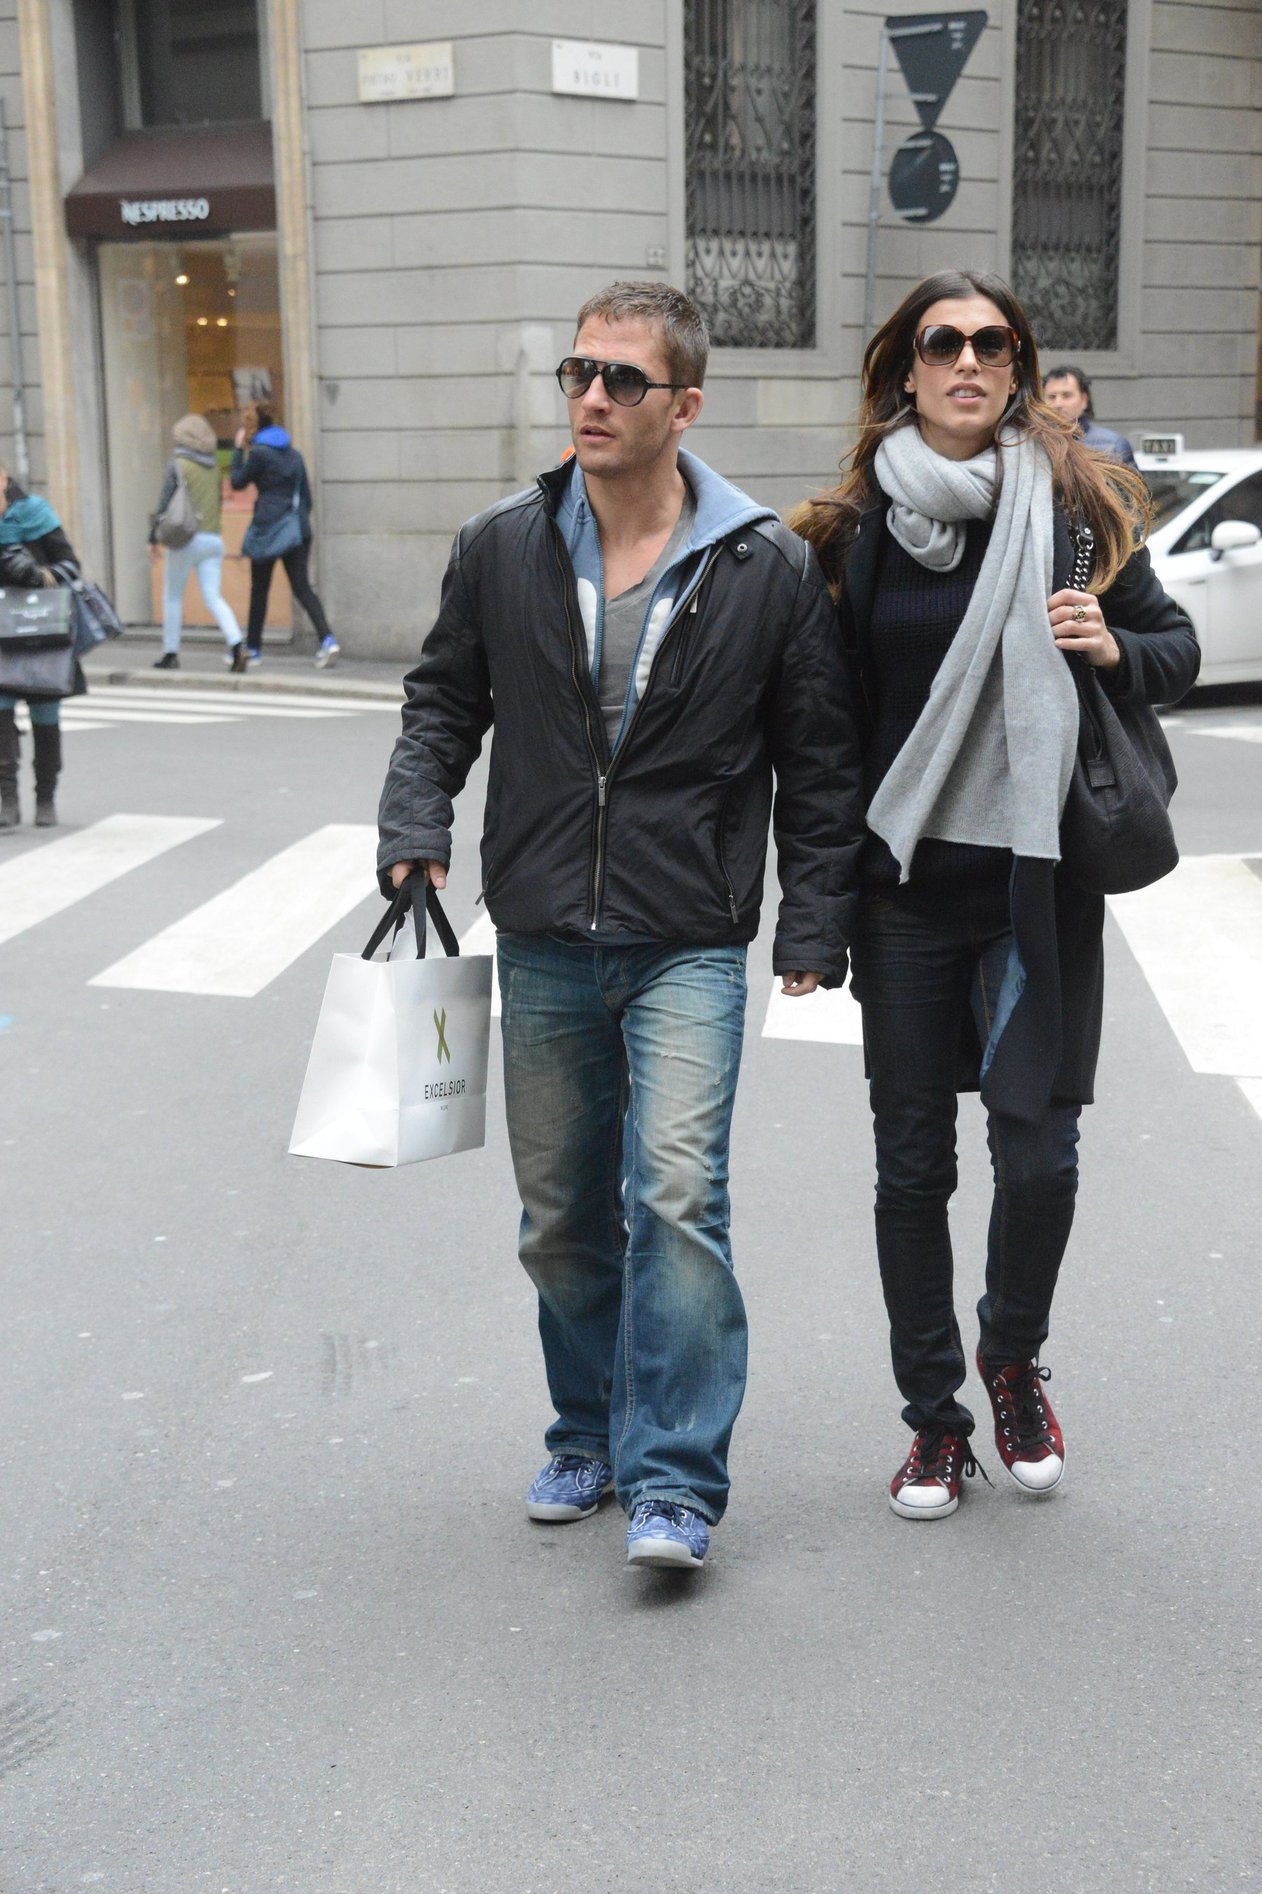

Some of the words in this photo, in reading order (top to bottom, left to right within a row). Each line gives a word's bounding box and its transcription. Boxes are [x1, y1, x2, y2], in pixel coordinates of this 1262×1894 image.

[573, 69, 621, 88] BIGLI
[119, 198, 210, 226] NESPRESSO
[424, 1079, 466, 1100] EXCELSIOR
